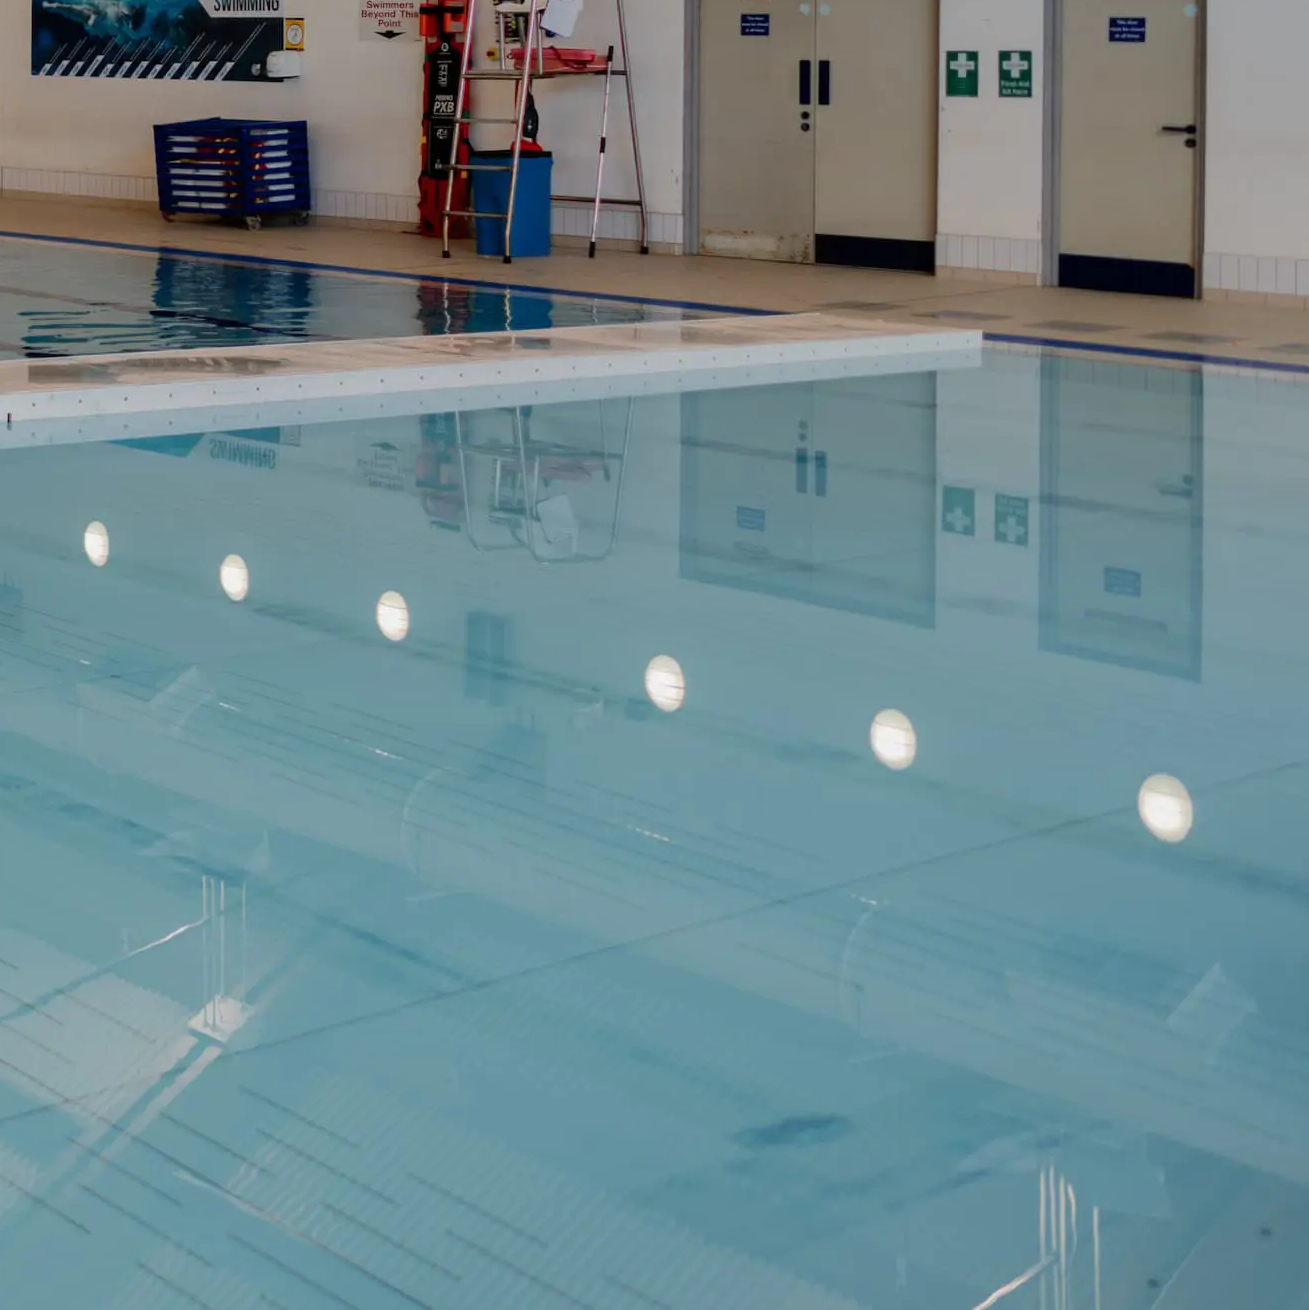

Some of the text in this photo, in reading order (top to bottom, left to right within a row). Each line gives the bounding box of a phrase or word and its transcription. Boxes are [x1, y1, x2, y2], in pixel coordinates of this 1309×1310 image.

[366, 0, 414, 9] Swimmers
[362, 10, 419, 18] Beyond This
[434, 101, 455, 113] PXB
